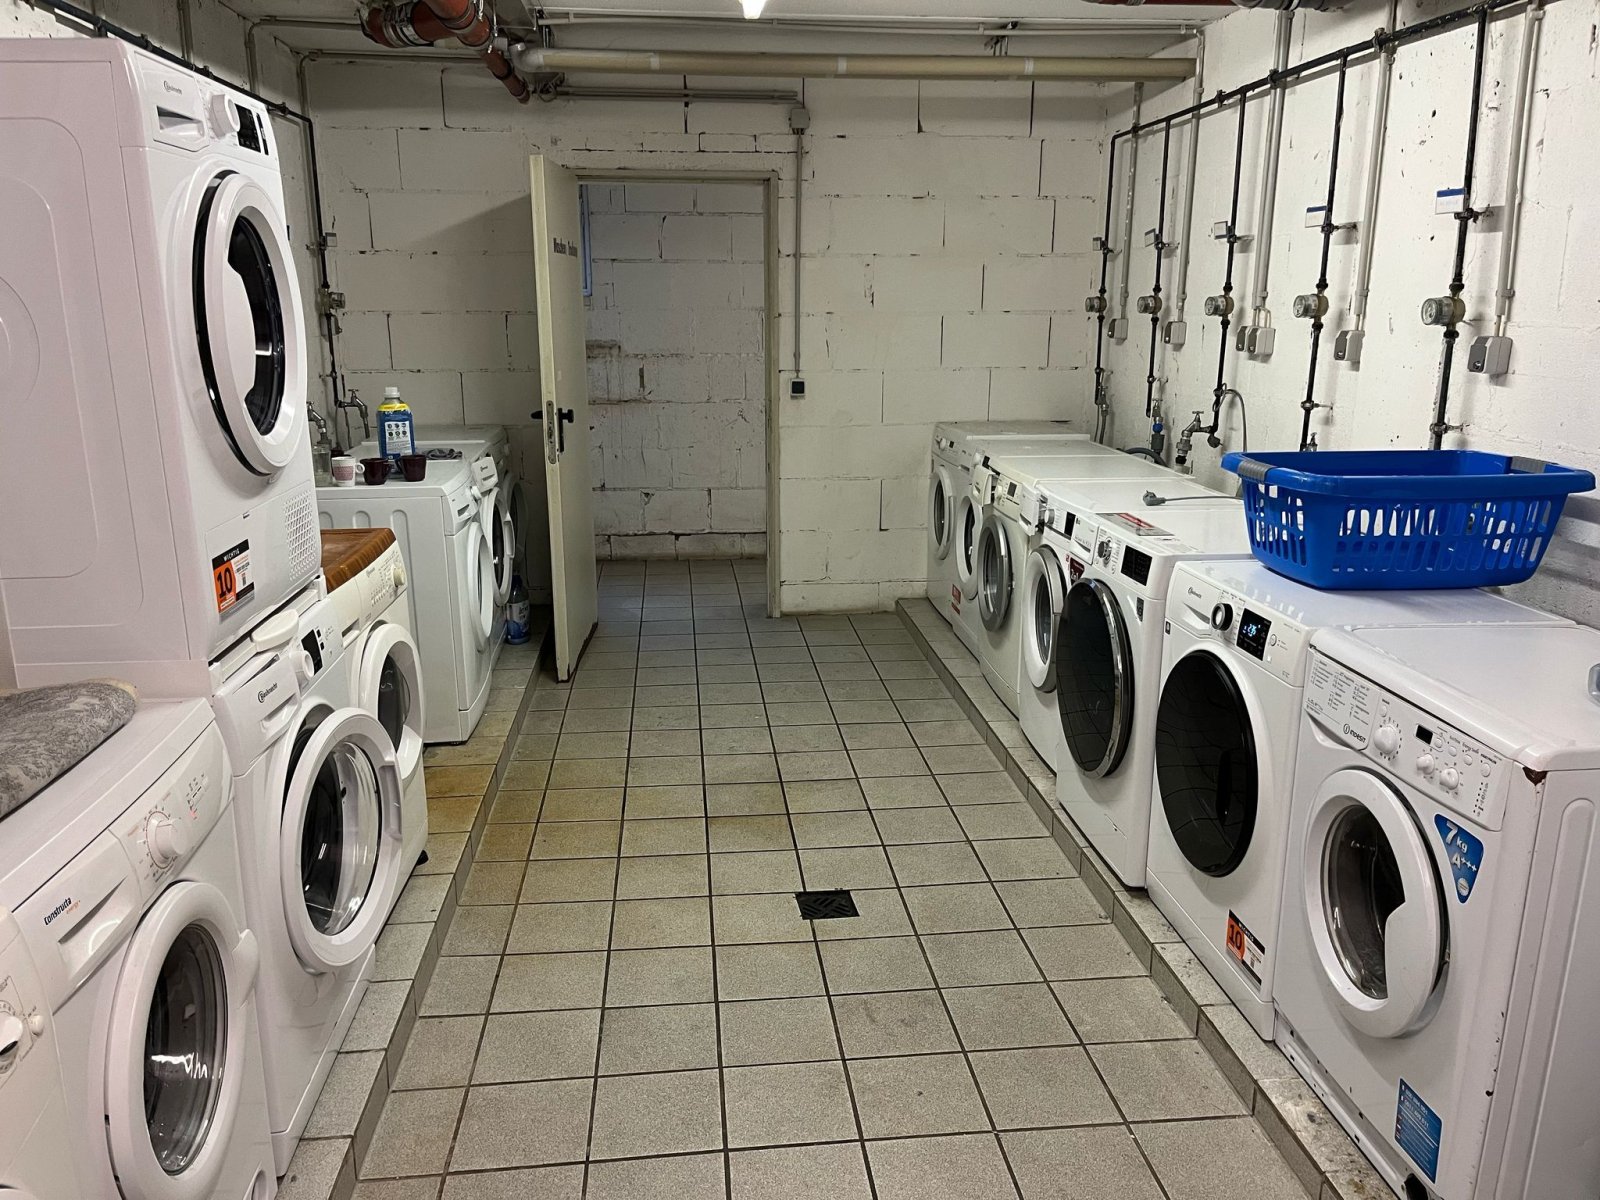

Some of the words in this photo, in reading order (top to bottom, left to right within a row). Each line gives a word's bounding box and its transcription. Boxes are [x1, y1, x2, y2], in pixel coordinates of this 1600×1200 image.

[217, 566, 233, 599] 10
[1445, 820, 1459, 845] 7
[1456, 836, 1468, 854] kg
[1451, 852, 1478, 872] A+++
[1228, 924, 1242, 950] 10
